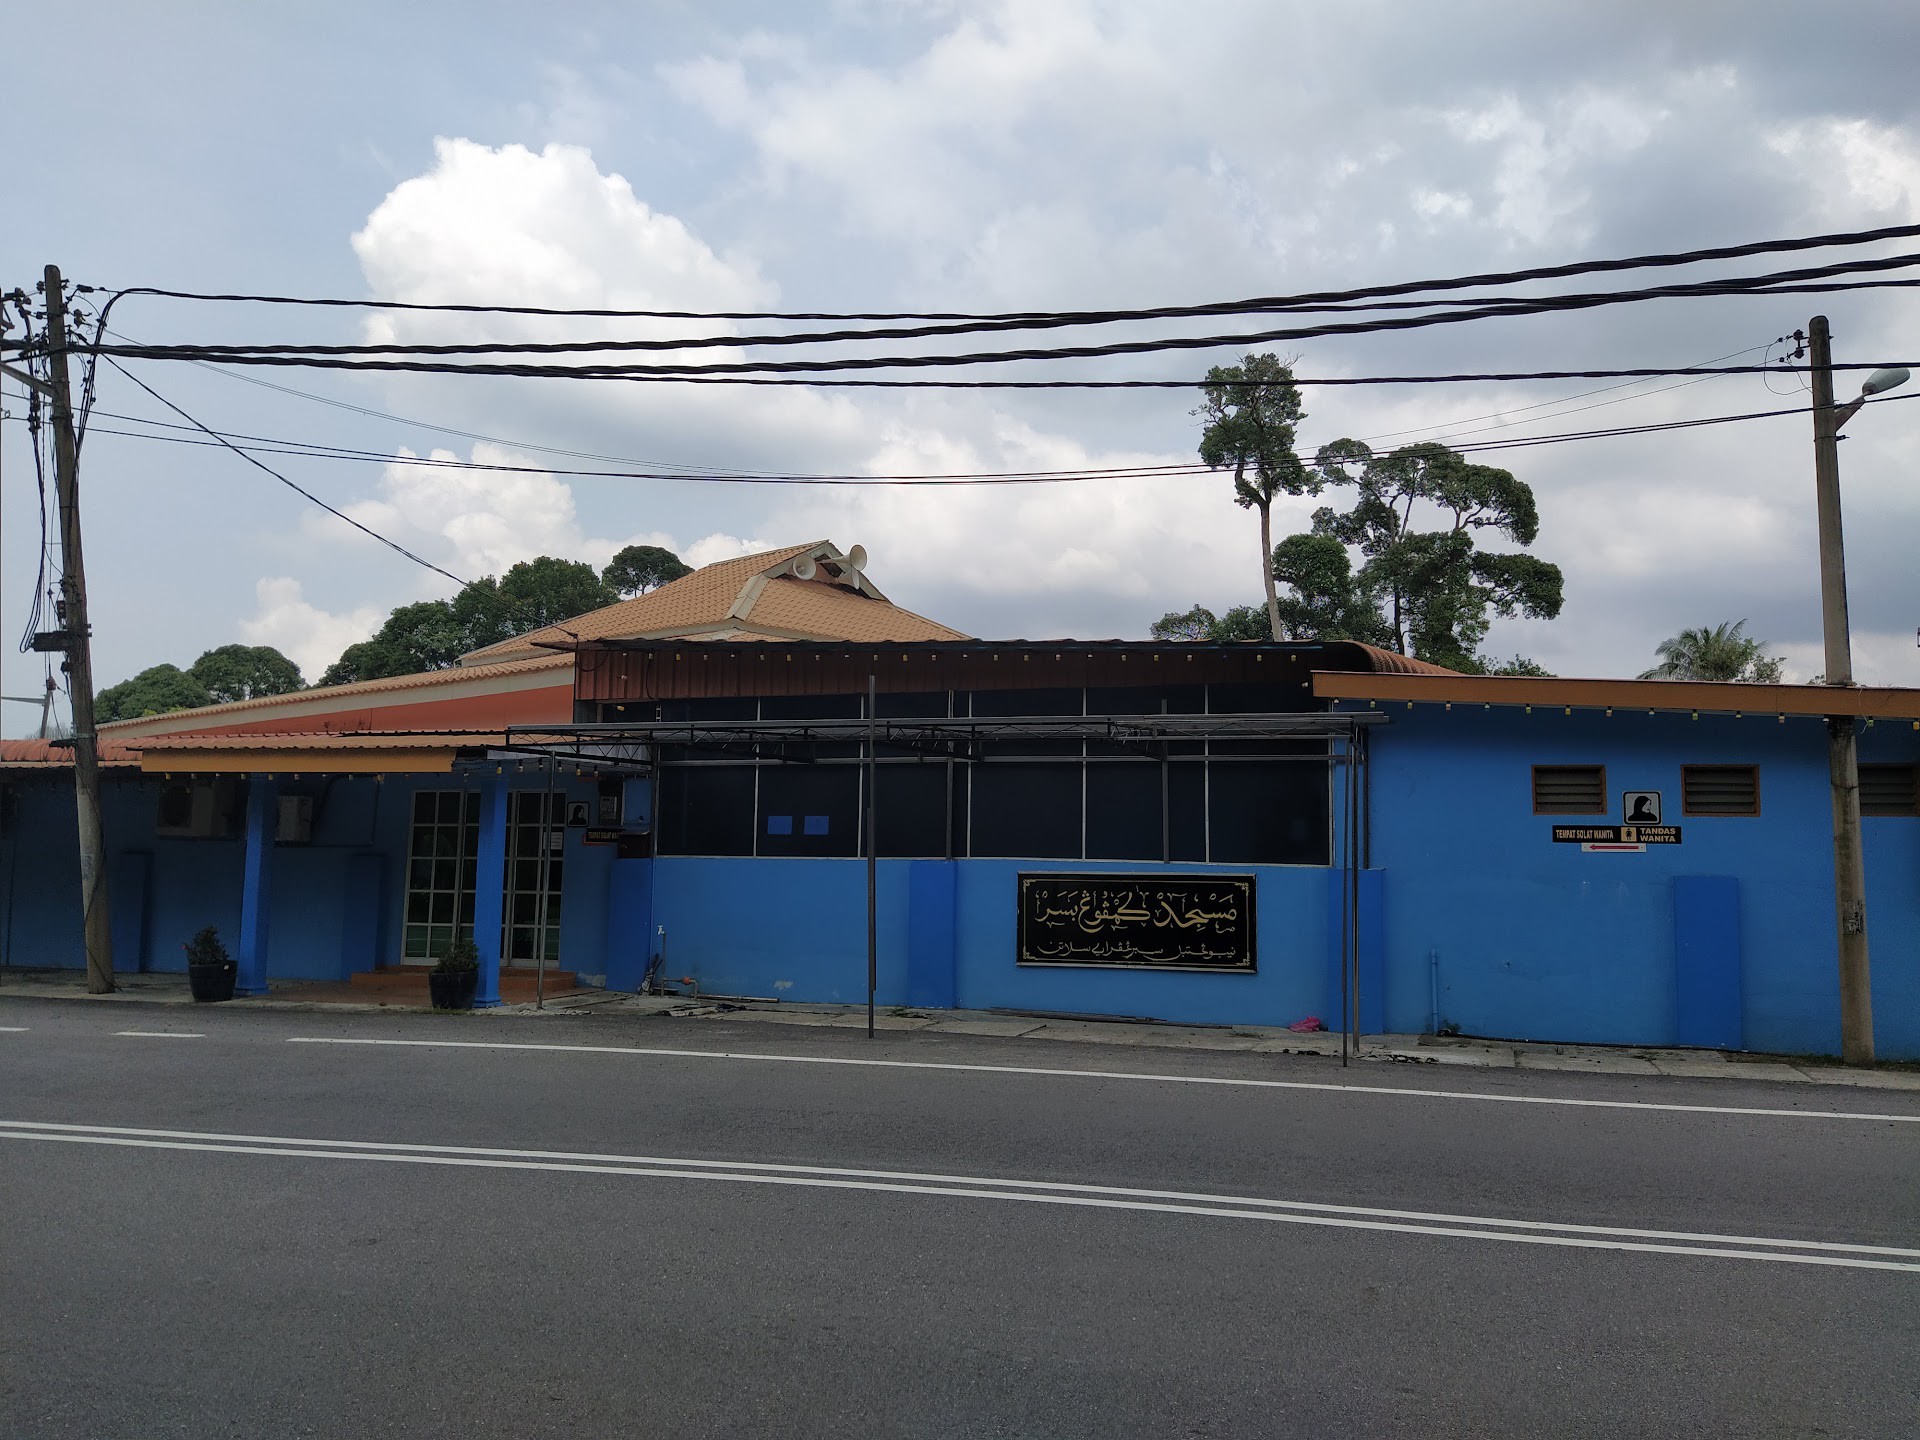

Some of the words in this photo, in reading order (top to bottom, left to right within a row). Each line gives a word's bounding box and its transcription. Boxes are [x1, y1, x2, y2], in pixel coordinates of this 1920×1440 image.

[1556, 829, 1576, 839] TEMPAT
[1576, 829, 1594, 839] SOLAT
[1594, 829, 1614, 840] WANITA
[1640, 827, 1676, 835] TANDAS
